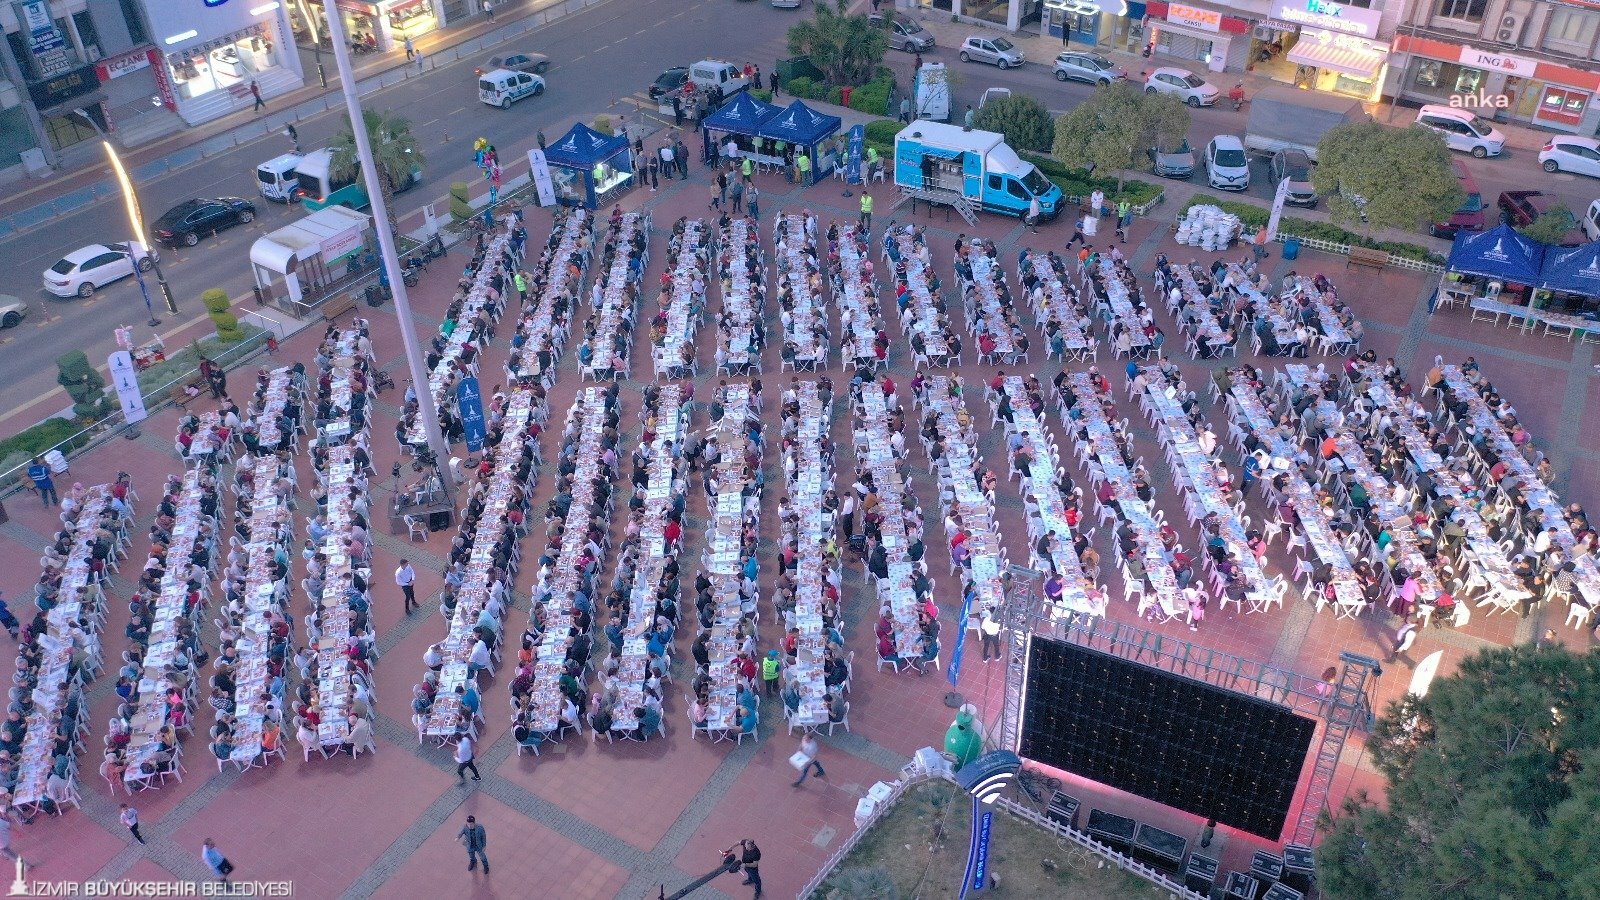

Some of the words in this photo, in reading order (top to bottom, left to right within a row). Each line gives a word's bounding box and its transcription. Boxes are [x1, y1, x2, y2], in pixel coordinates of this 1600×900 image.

[1170, 5, 1218, 24] ECZANE
[1183, 19, 1202, 27] CANSU
[109, 52, 146, 72] ECZANE
[1477, 55, 1501, 67] ING
